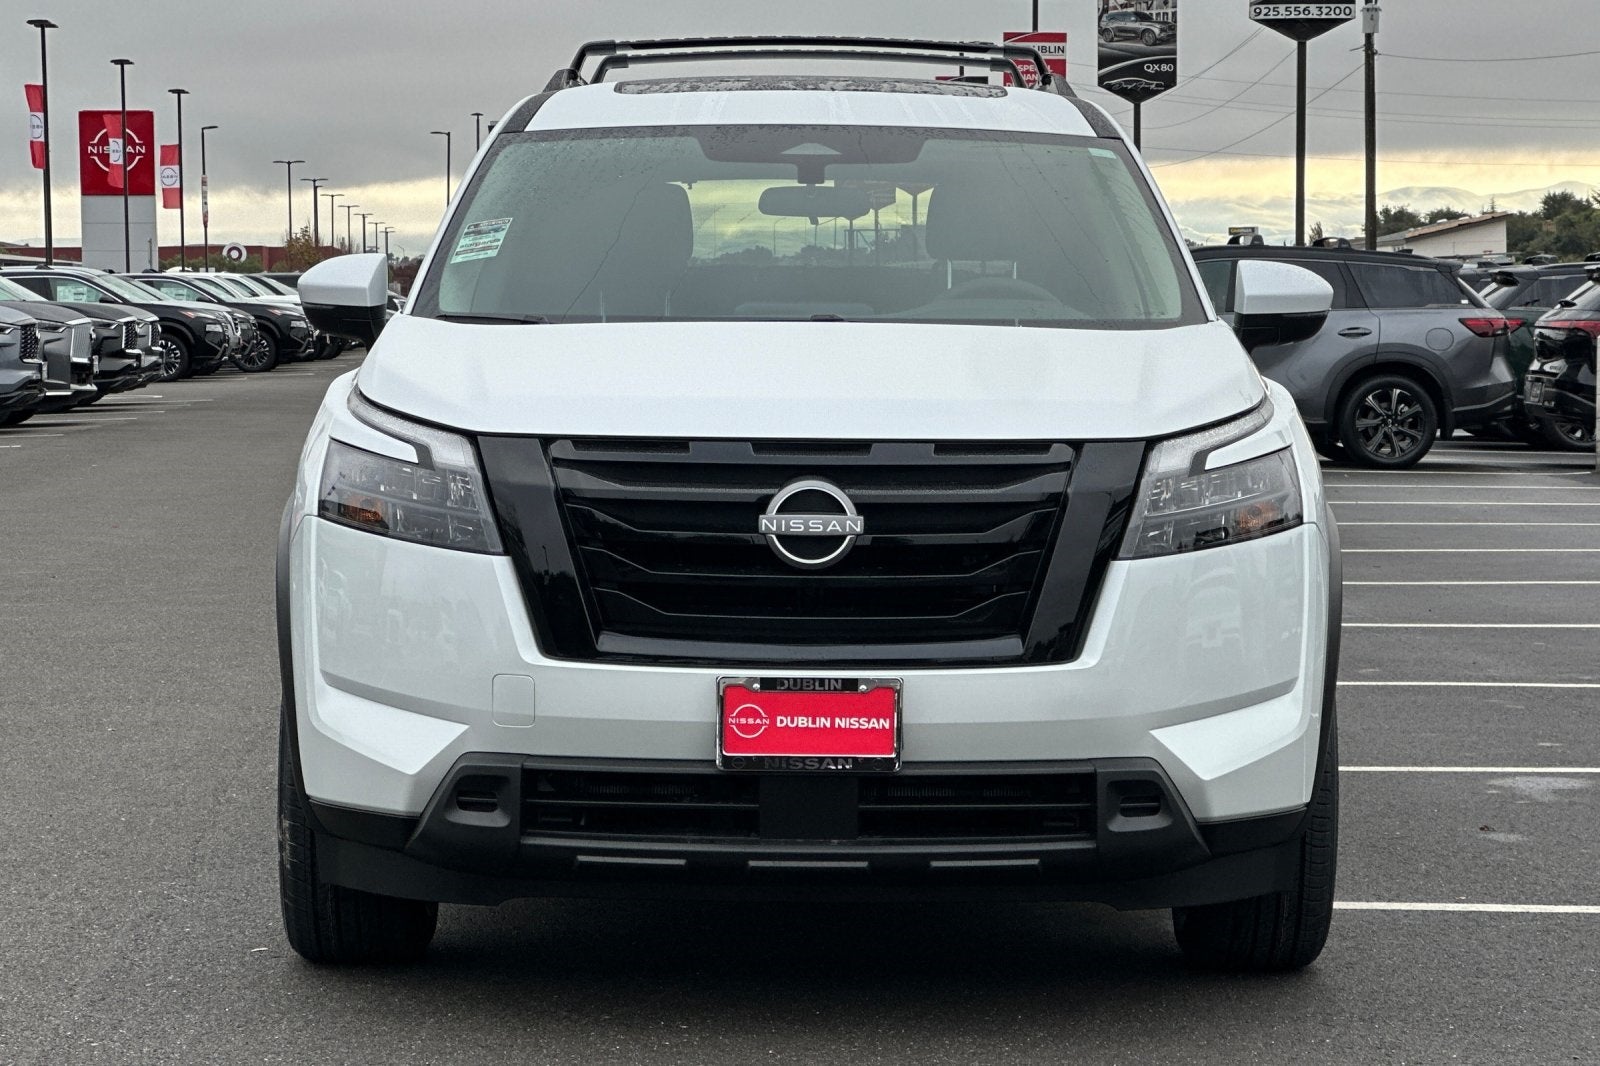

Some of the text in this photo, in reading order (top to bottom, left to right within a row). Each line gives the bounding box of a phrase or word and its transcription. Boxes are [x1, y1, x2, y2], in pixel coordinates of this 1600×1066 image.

[1253, 6, 1352, 17] 925.556.3200
[1144, 63, 1174, 73] QX80
[87, 145, 146, 154] NISAN
[761, 518, 861, 532] NISSAN
[776, 678, 842, 691] DUBLIN
[728, 717, 770, 725] NISSAN
[776, 716, 890, 730] DUBLIN NISSAN
[763, 757, 853, 770] NISSAN
